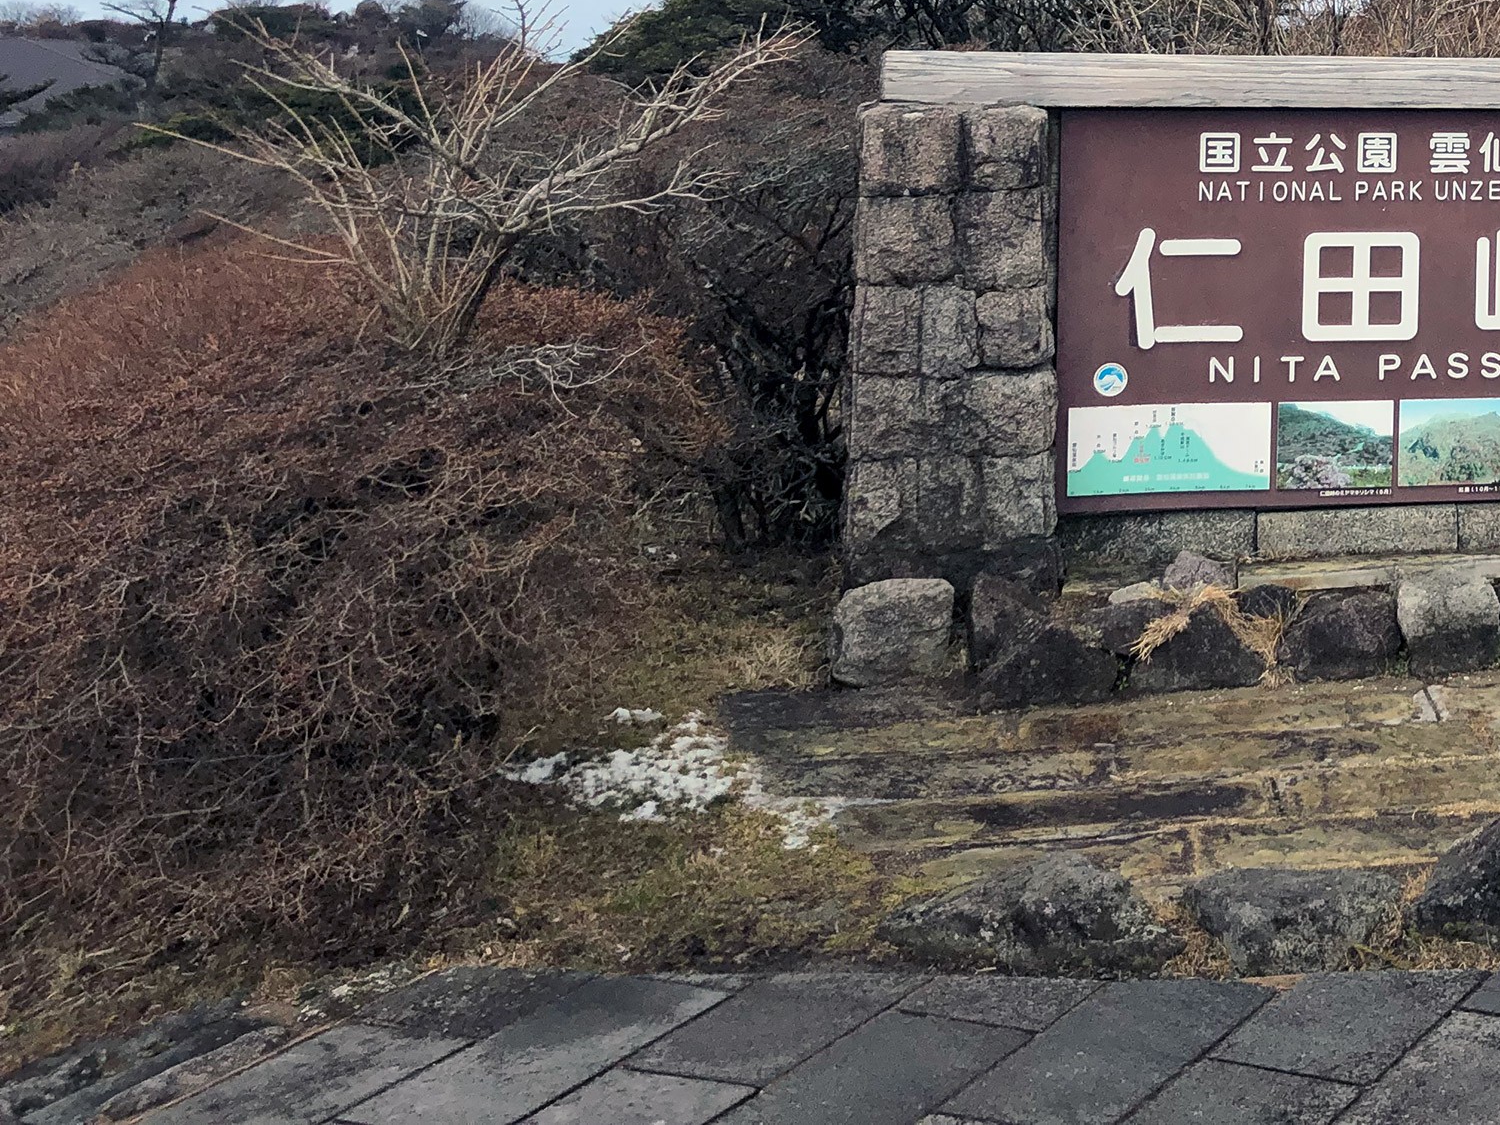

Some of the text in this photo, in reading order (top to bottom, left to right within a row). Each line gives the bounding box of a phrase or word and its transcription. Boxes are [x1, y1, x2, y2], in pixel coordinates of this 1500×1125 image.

[1199, 131, 1398, 174] 国立公園
[1198, 180, 1342, 202] NATIONAL
[1355, 180, 1423, 202] PARK
[1209, 354, 1341, 383] NITA
